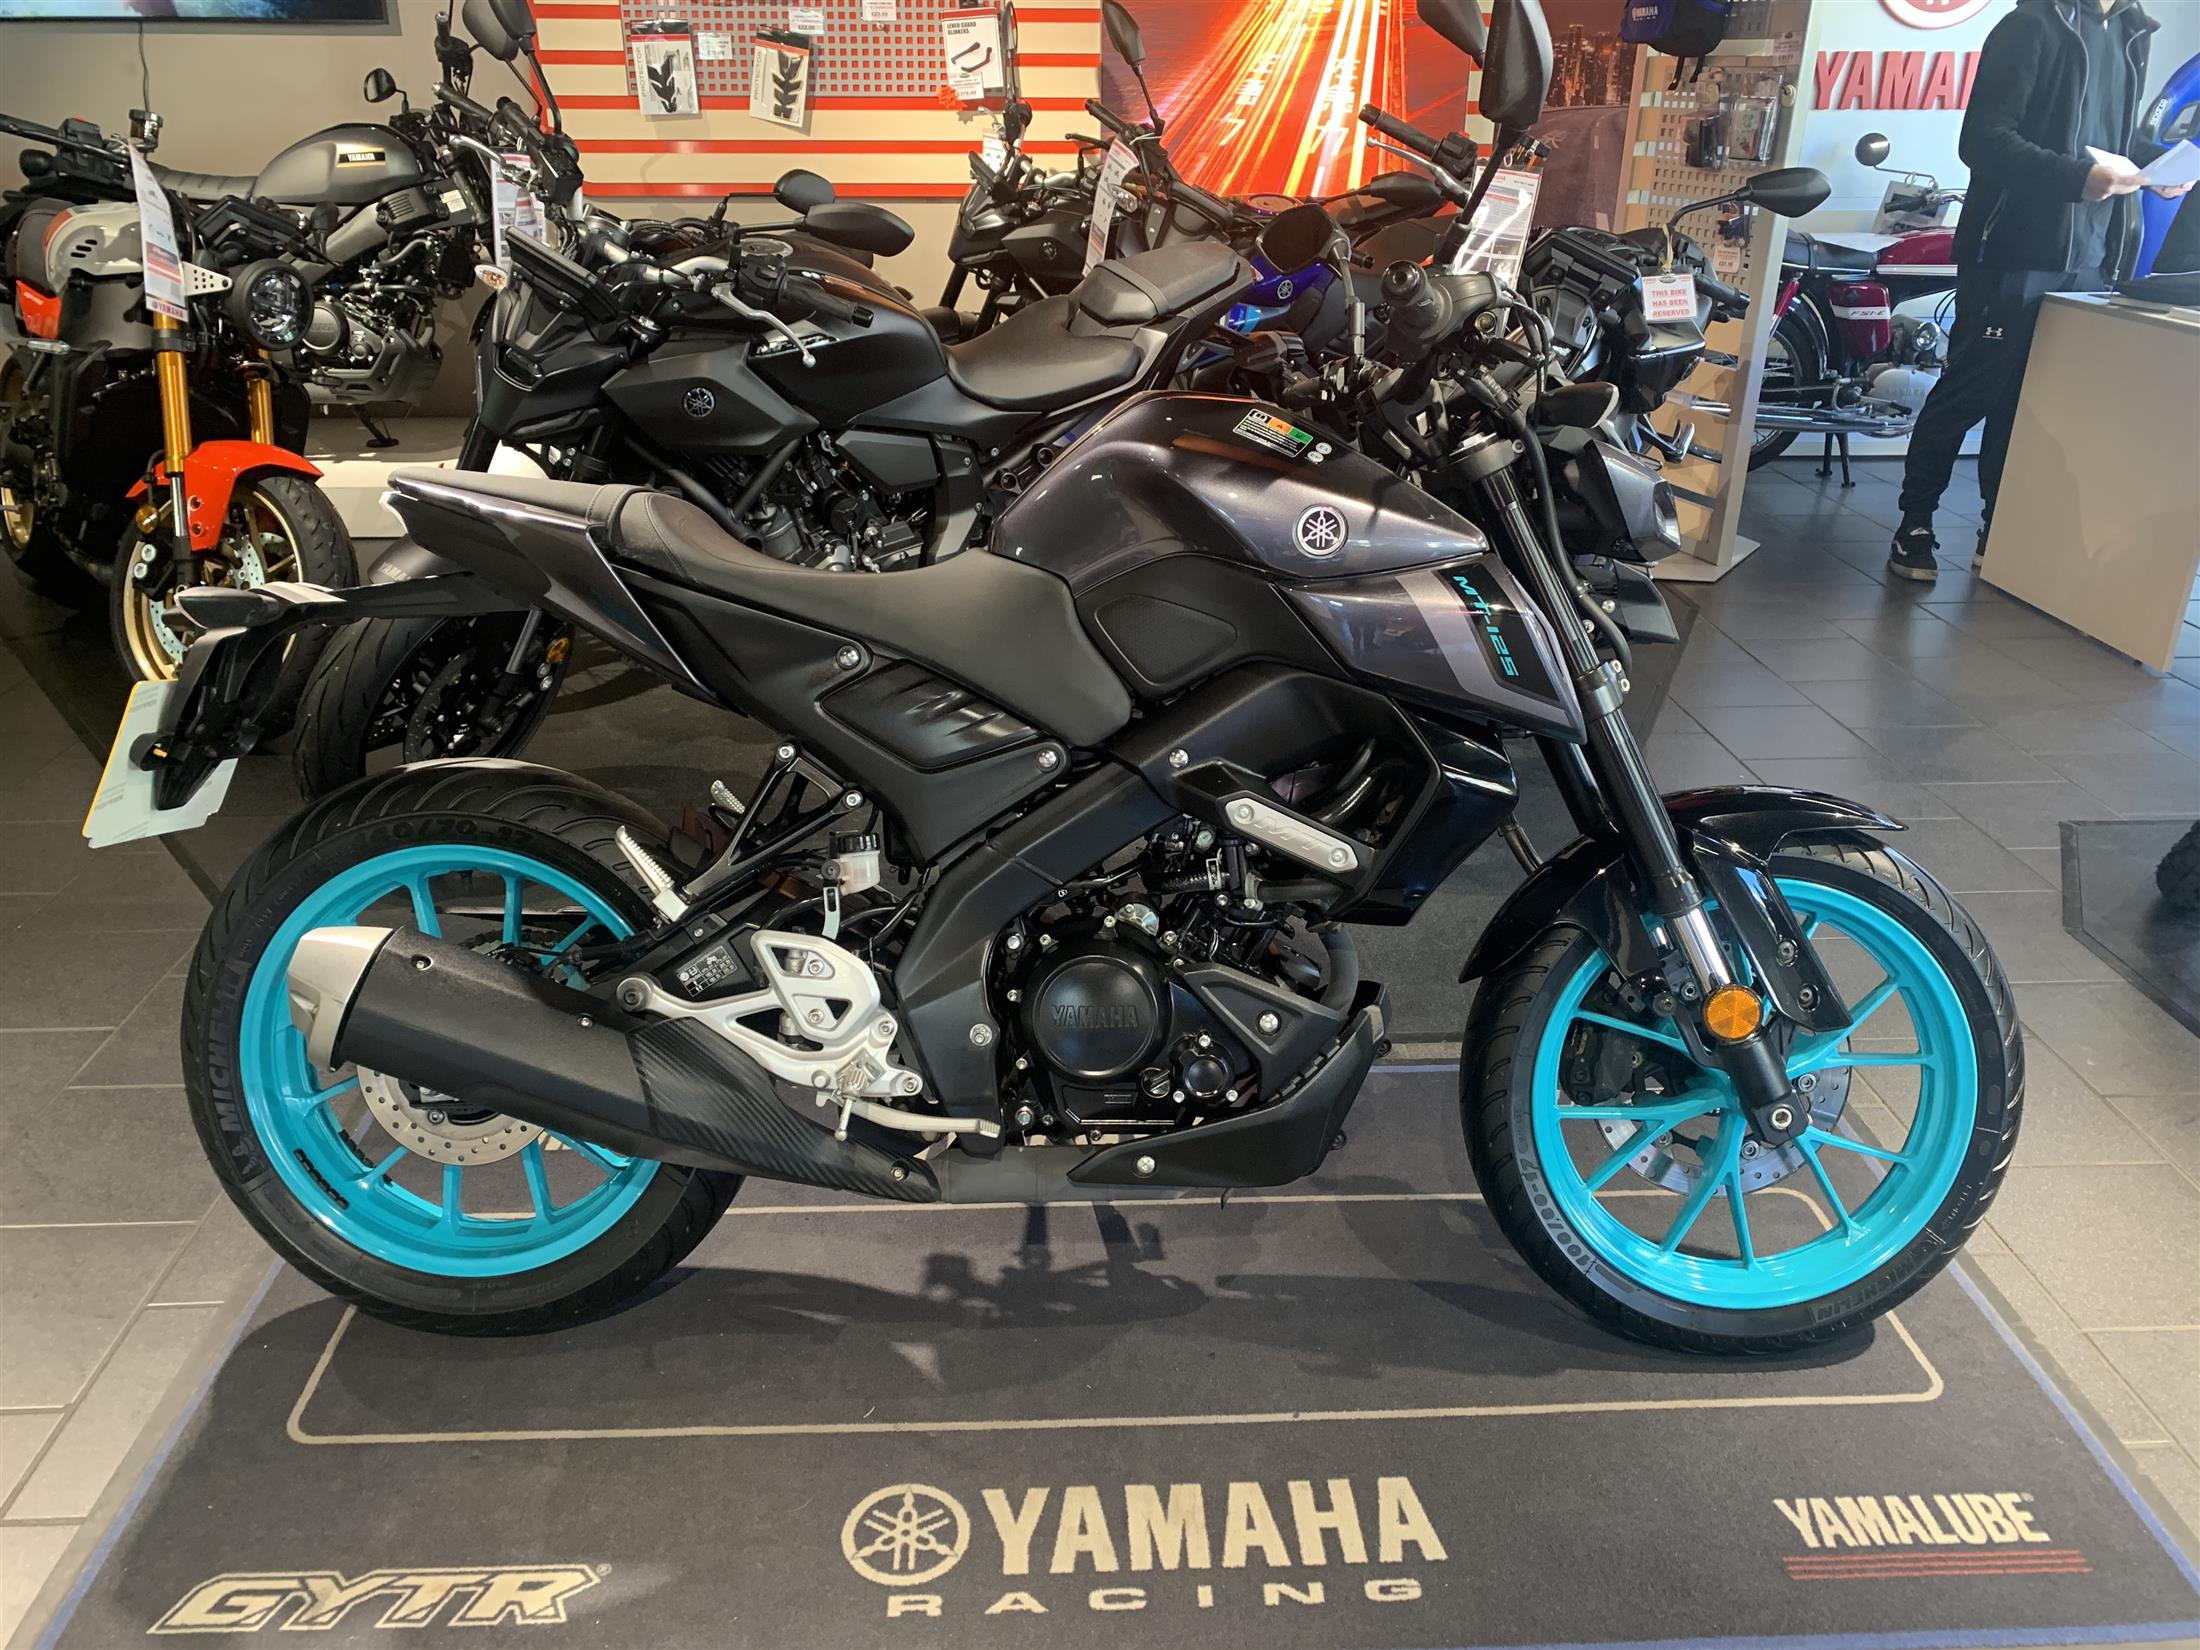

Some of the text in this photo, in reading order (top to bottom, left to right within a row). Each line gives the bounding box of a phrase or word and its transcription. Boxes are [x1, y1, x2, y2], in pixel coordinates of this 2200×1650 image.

[636, 46, 647, 98] PROTECTOR
[753, 50, 763, 101] PROTECTOR
[1812, 50, 1982, 110] YAMA
[347, 152, 376, 162] YAMAHA
[159, 302, 184, 319] YAMAHA
[1652, 309, 1690, 317] RESERVED
[1452, 576, 1519, 676] MT-125
[1253, 815, 1334, 851] MT
[1051, 1004, 1140, 1030] YAMAHA
[207, 962, 243, 1132] MICHELIN
[1519, 1158, 1592, 1267] 100/80-17
[1817, 1247, 1917, 1321] MICHELIN
[980, 1475, 1449, 1577] YAMAHA
[1772, 1492, 2051, 1549] YAMALUBE
[146, 1563, 602, 1635] GYTR
[886, 1578, 1423, 1619] RACING
